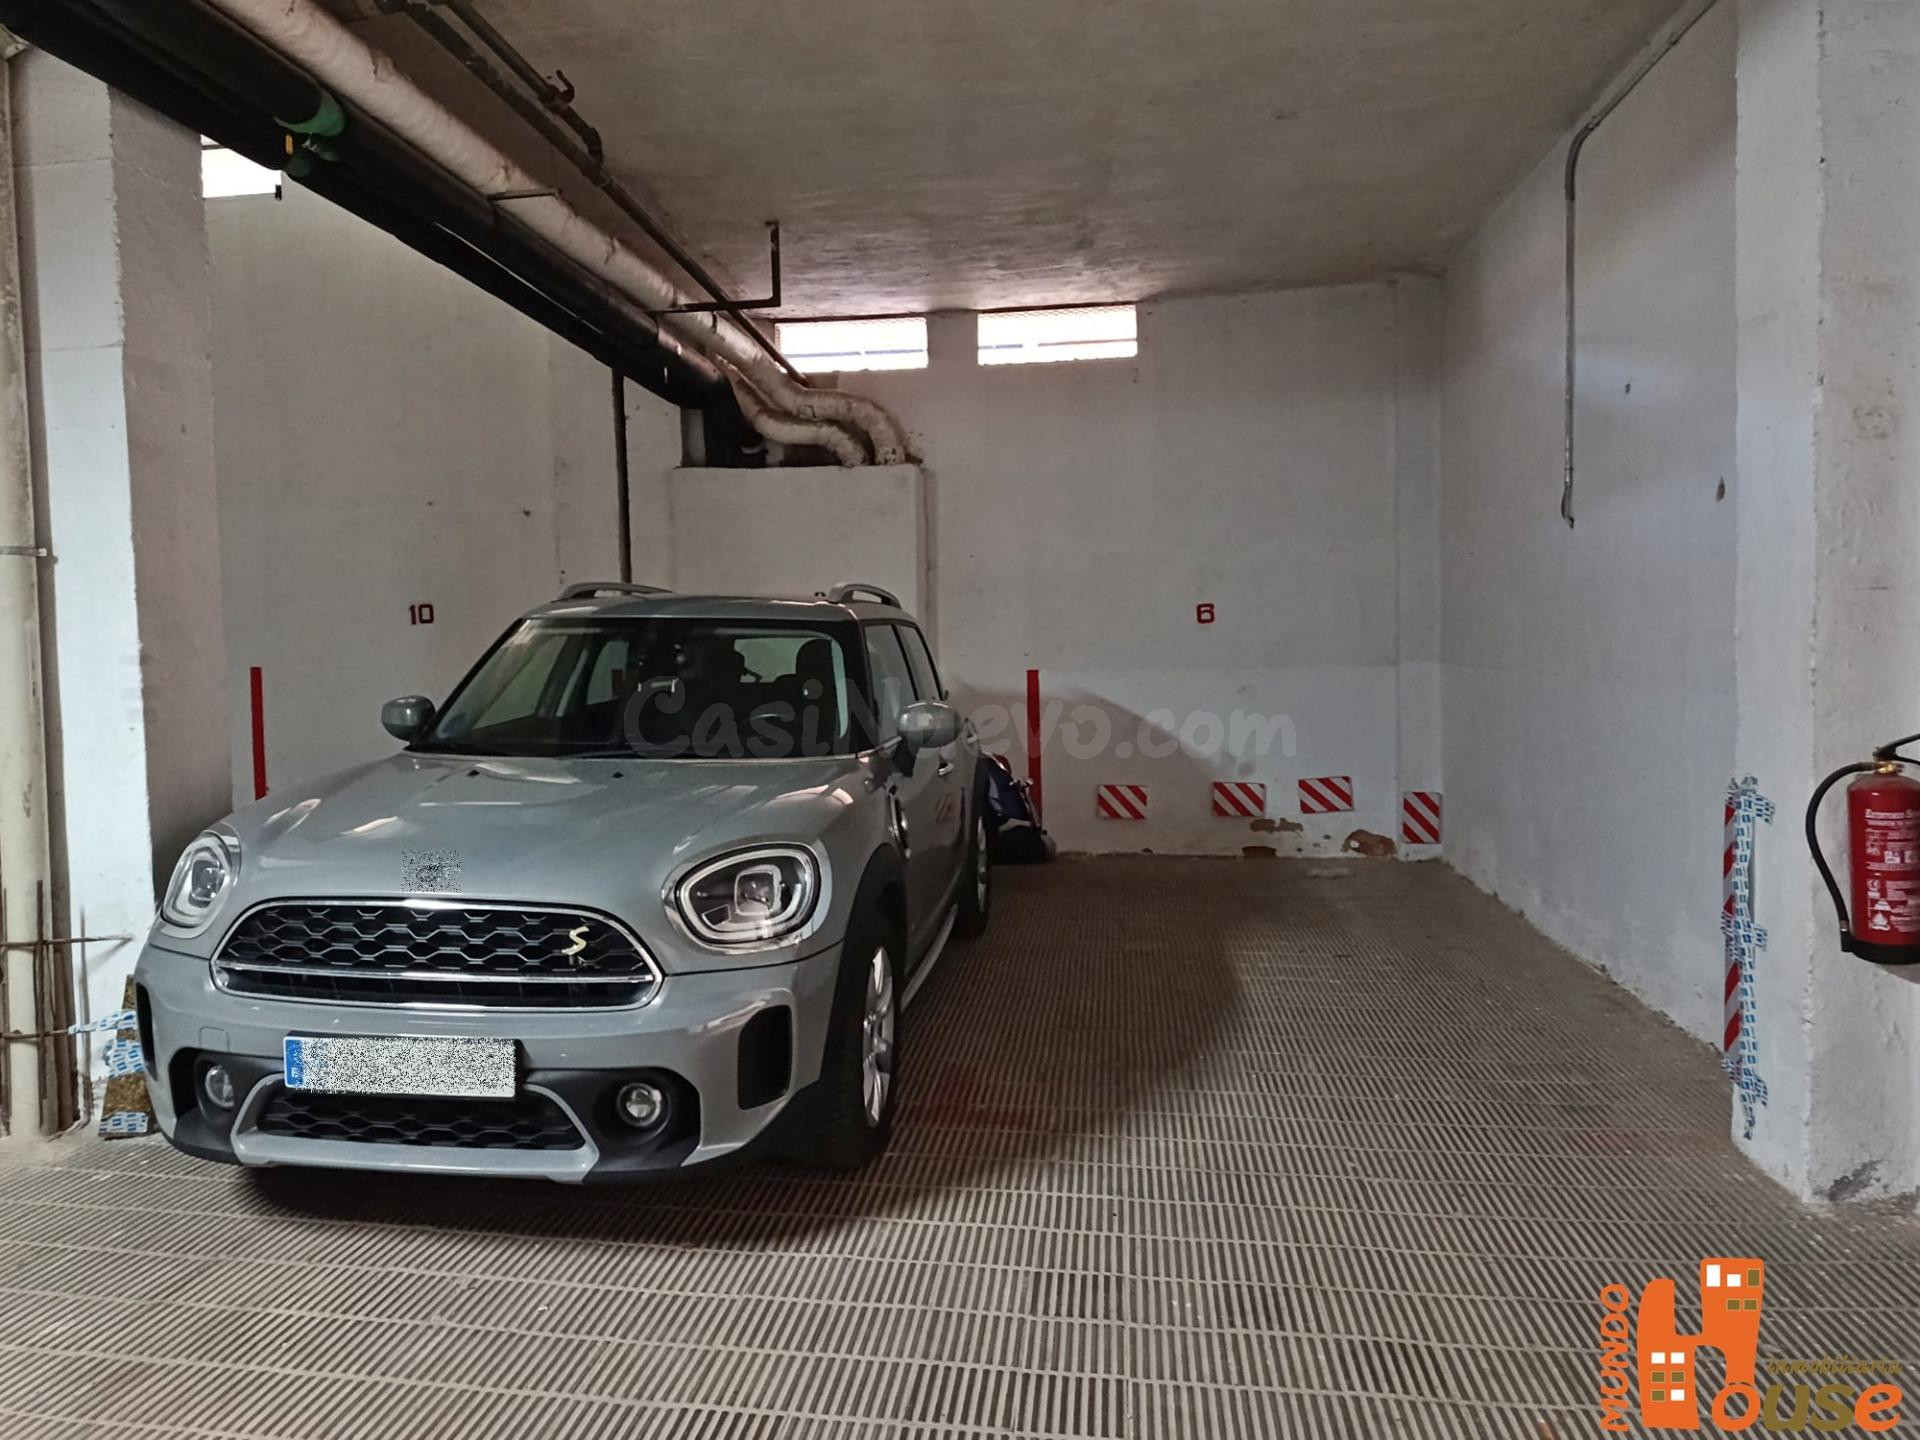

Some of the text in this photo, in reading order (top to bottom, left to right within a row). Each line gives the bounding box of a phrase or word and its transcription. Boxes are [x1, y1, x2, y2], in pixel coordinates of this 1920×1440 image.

[409, 604, 434, 625] 10
[1196, 603, 1215, 624] 6
[561, 926, 589, 956] S
